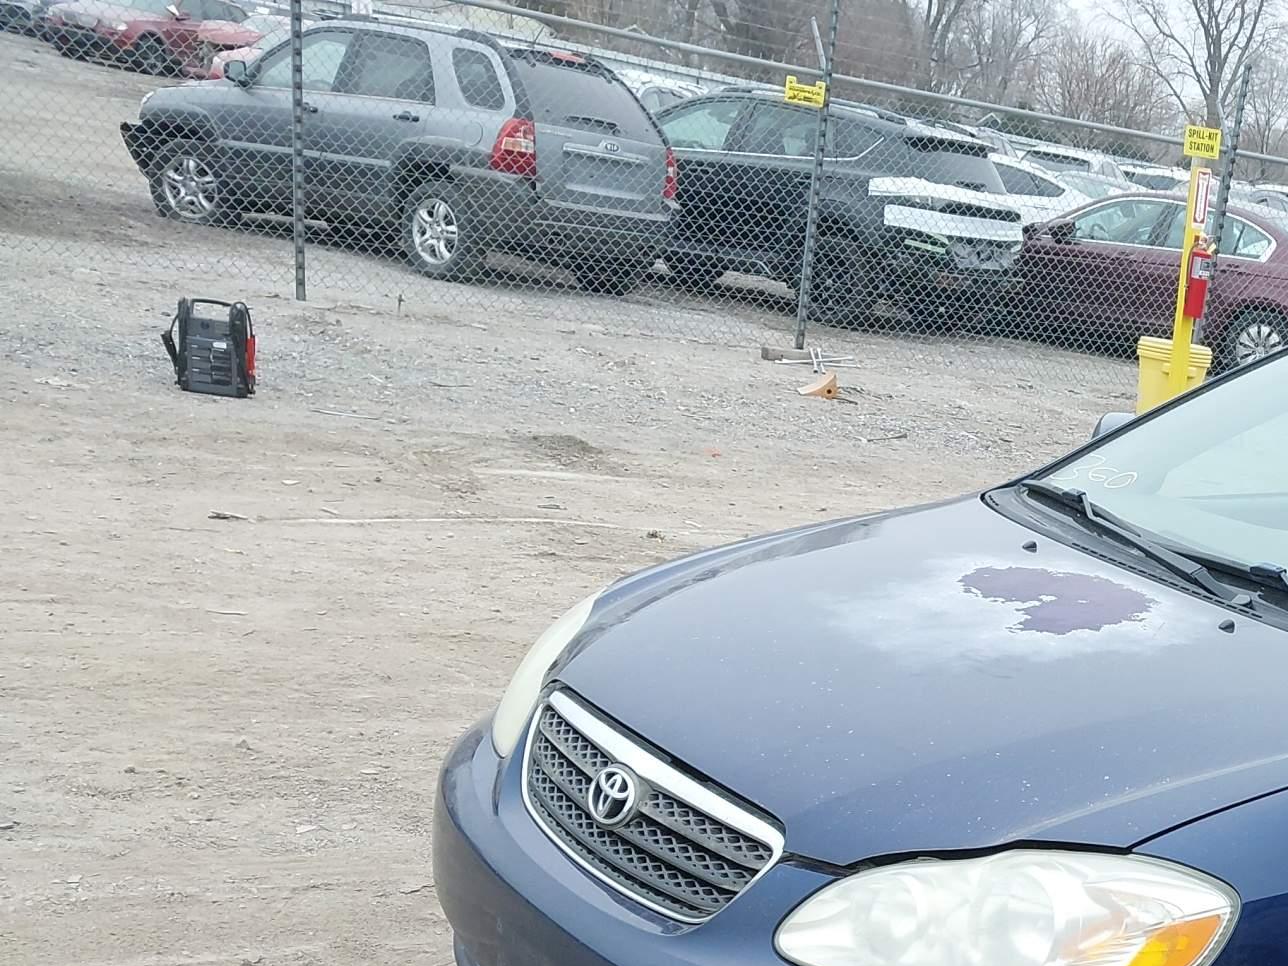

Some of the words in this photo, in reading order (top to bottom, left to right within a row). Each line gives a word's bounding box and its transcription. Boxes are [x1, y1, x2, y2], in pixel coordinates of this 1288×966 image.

[1188, 128, 1219, 142] SPILL-KIT
[1188, 140, 1215, 154] STATION
[1050, 453, 1137, 489] 360
